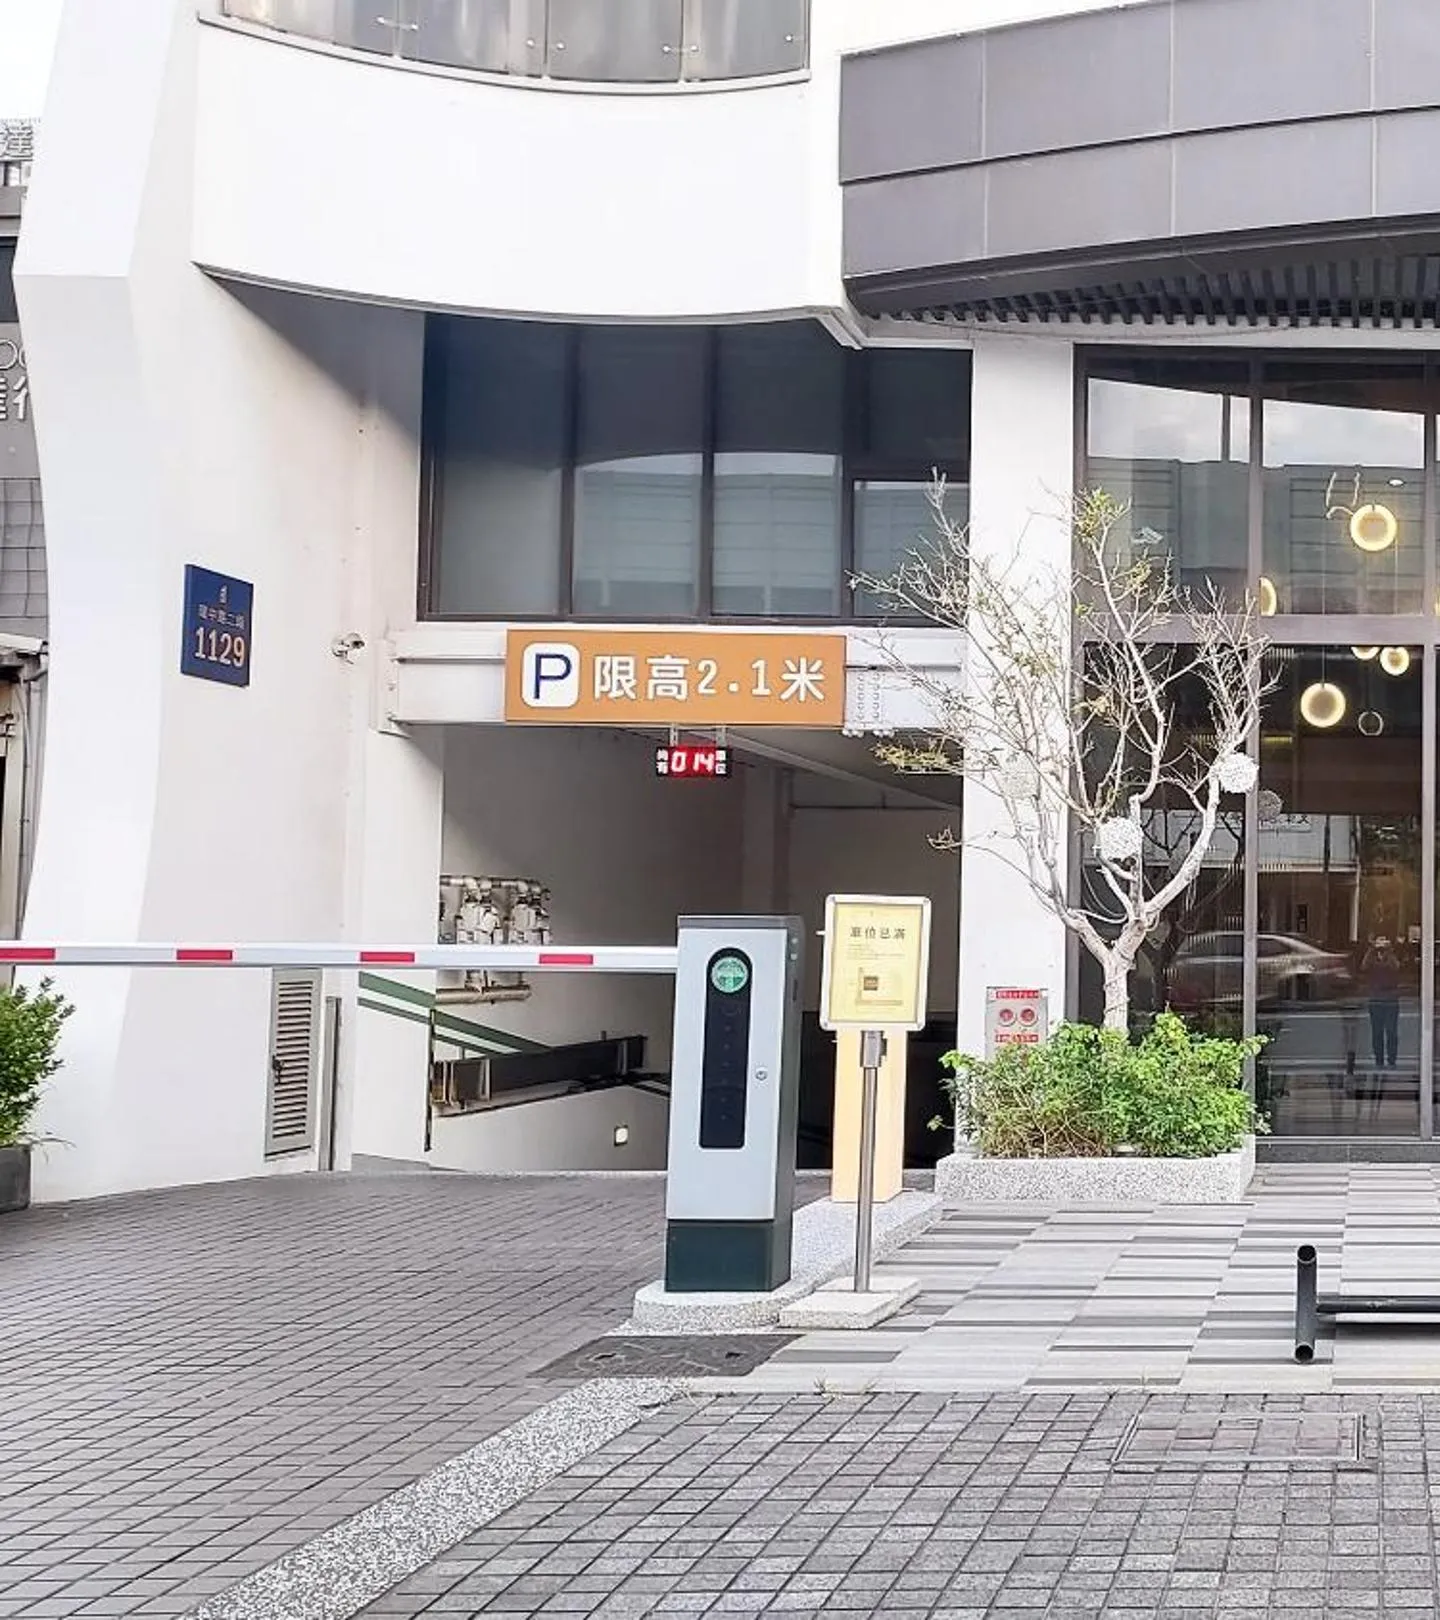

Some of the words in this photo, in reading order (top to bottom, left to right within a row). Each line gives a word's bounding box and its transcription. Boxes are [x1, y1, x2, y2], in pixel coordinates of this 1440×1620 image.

[195, 627, 245, 667] 1129
[534, 653, 573, 699] P
[594, 655, 825, 701] 限高2.1米
